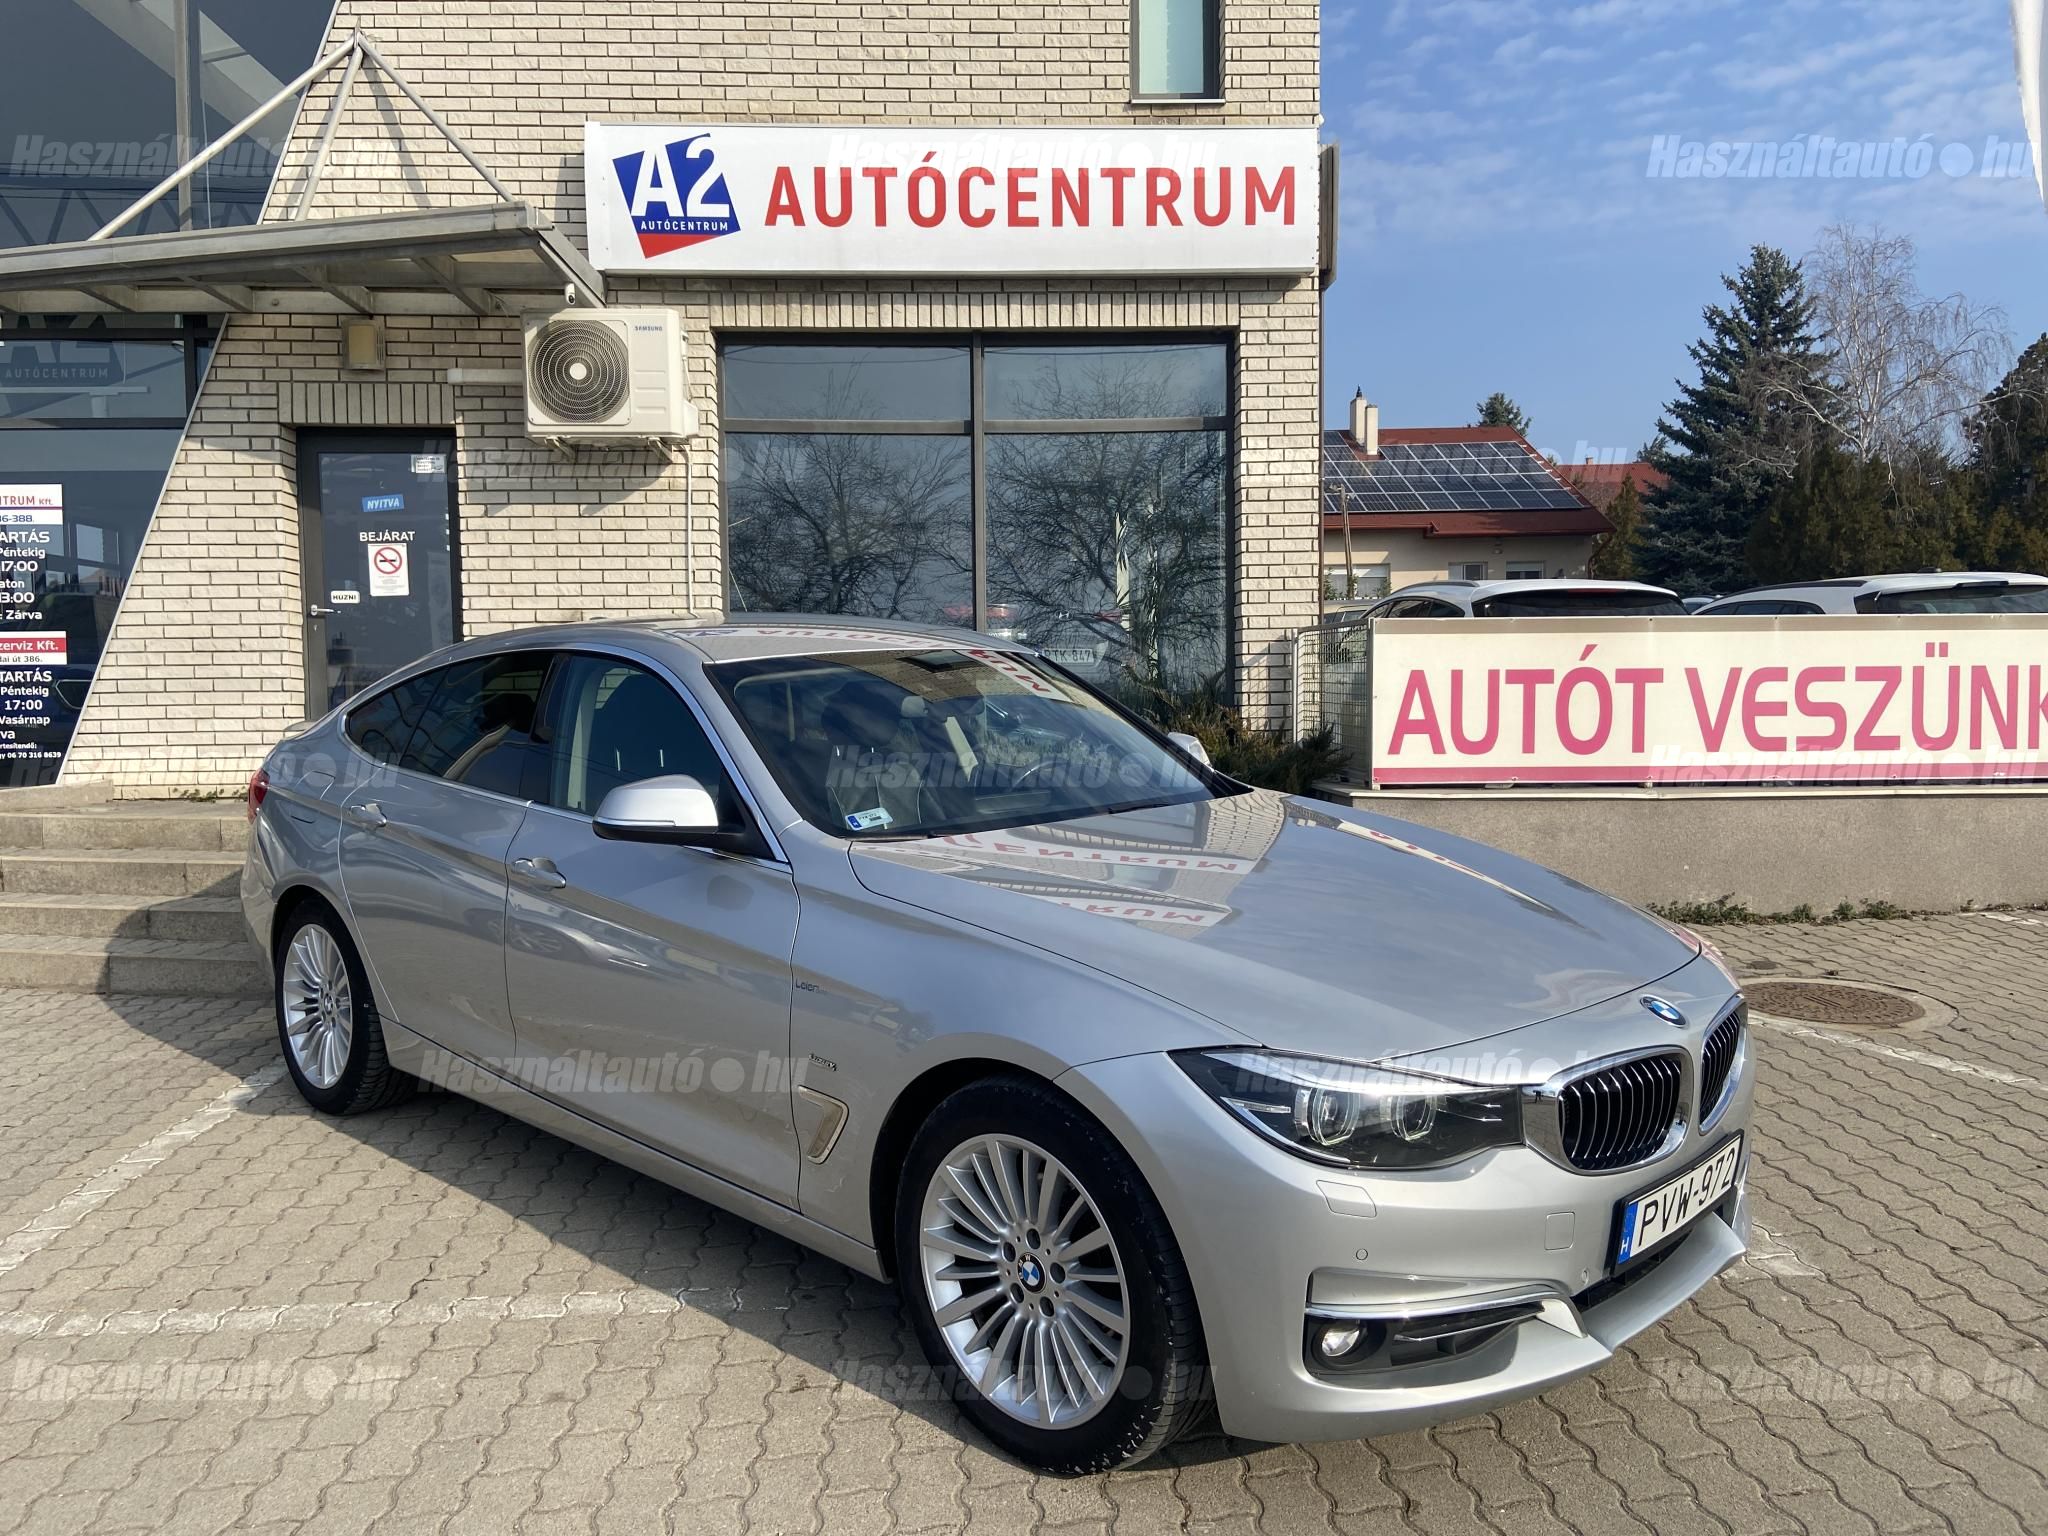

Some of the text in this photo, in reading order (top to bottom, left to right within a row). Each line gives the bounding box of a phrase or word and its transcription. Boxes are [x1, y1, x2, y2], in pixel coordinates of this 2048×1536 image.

[630, 135, 730, 217] A2
[764, 151, 1295, 228] AUTÓCENTRUM
[640, 218, 728, 231] AUTÓCENTRUM
[0, 496, 35, 505] TRUM
[367, 498, 400, 510] NYITVA
[359, 530, 416, 542] BEJÁRAT
[0, 592, 35, 603] 3:00
[5, 610, 43, 620] Zárva
[36, 641, 59, 651] Kft.
[1, 686, 49, 697] Péntekig
[5, 700, 42, 710] 17:00
[1388, 644, 1664, 755] AUTÓT
[1638, 1147, 1735, 1247] PVW-972
[1620, 1238, 1629, 1255] H
